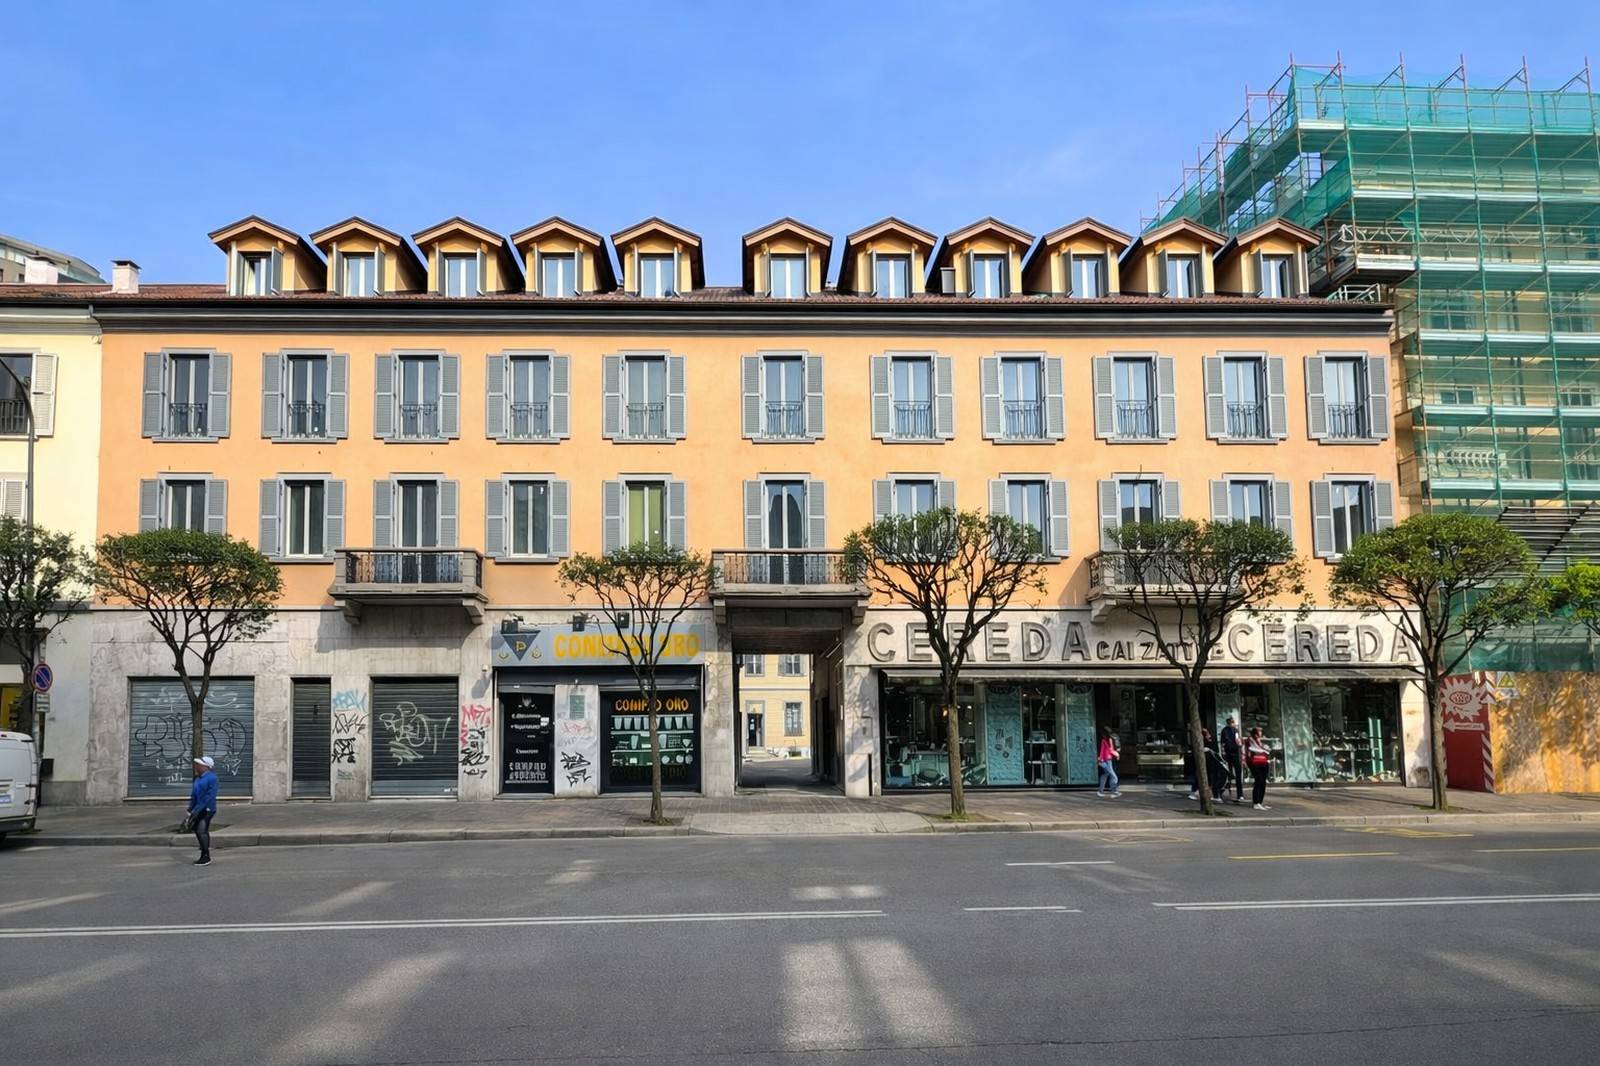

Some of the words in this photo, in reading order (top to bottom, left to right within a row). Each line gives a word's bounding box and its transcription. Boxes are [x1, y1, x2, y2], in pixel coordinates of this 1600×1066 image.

[868, 621, 1092, 662] CEREDA
[1097, 641, 1225, 660] CALZATUE
[1227, 623, 1416, 662] CEREDA
[615, 699, 662, 711] COMPO
[666, 698, 689, 711] ORO
